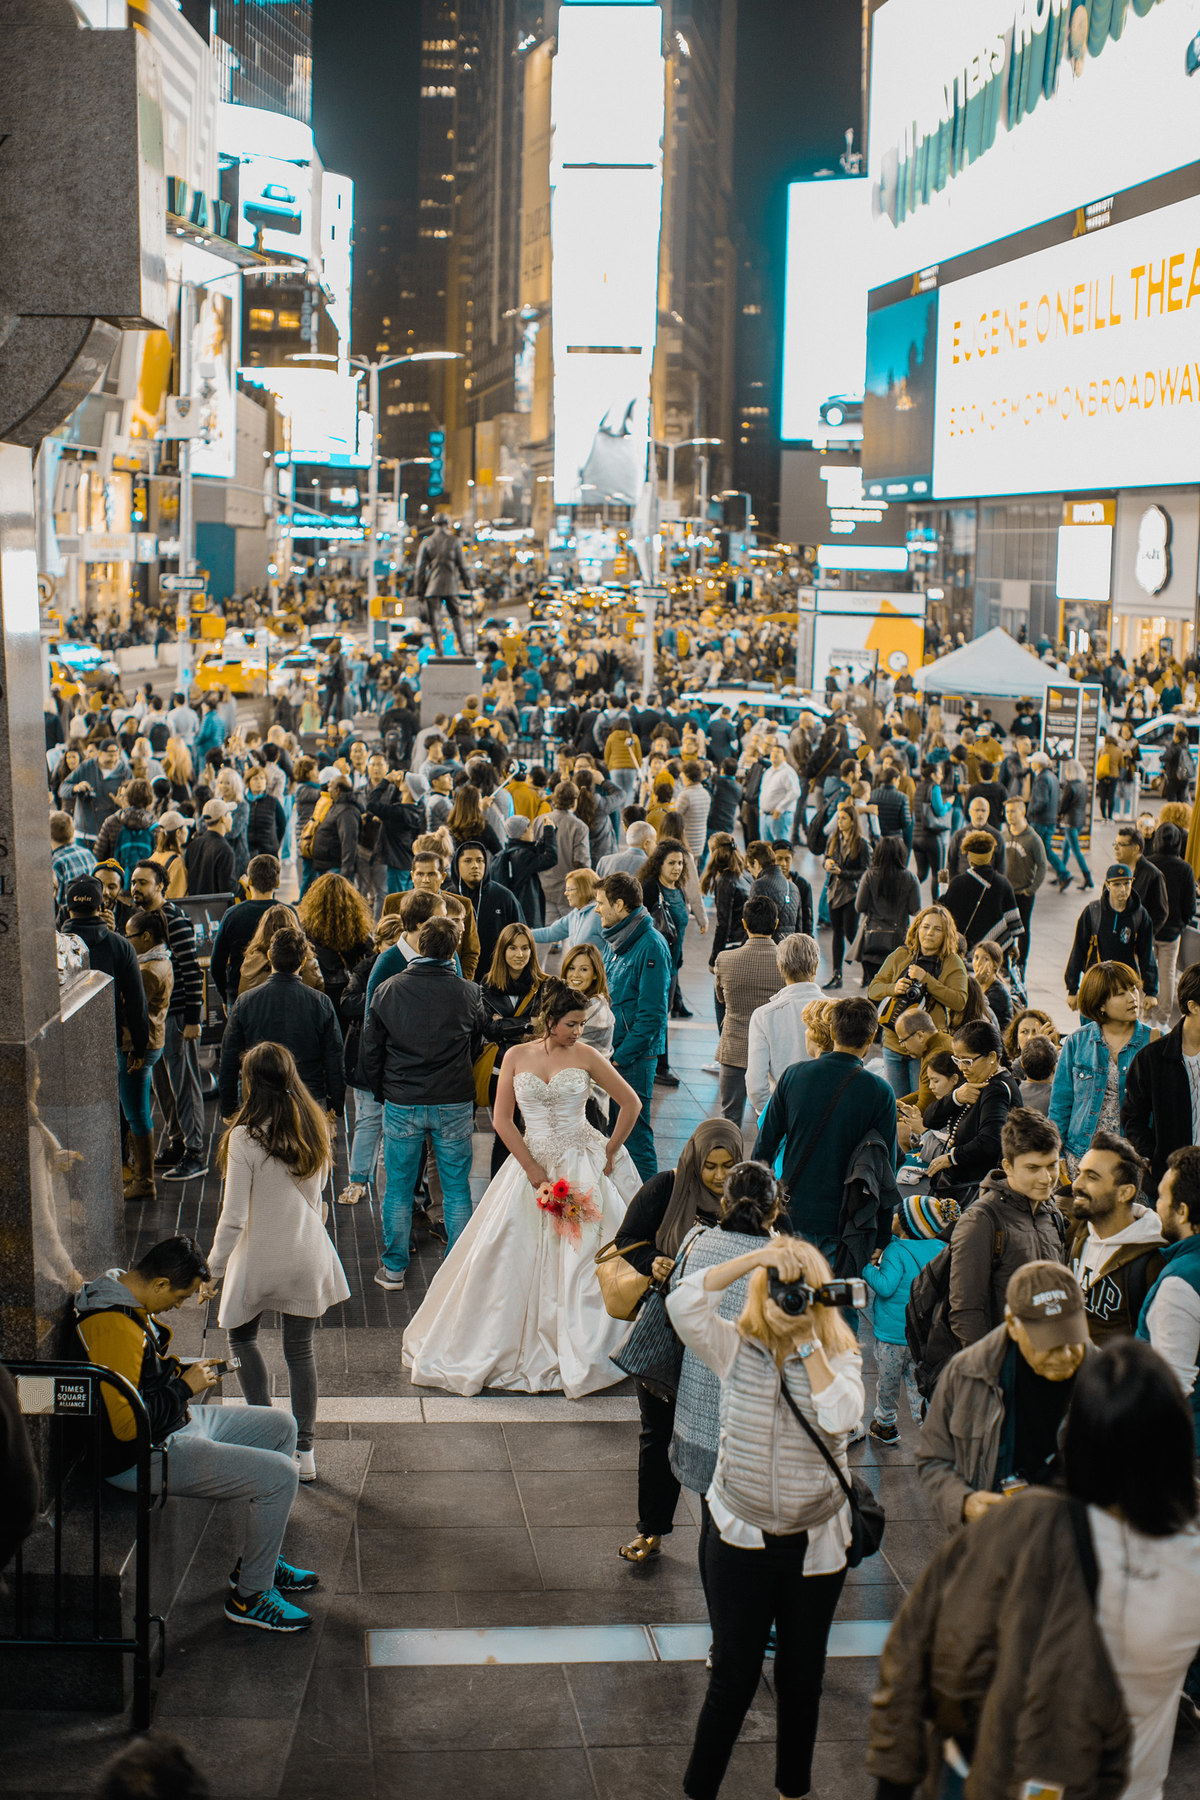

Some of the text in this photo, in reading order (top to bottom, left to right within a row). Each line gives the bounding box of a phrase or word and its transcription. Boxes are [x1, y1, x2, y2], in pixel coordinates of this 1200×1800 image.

[1073, 1258, 1122, 1320] AP
[60, 1385, 84, 1393] TIMES
[57, 1393, 87, 1402] SQUARE
